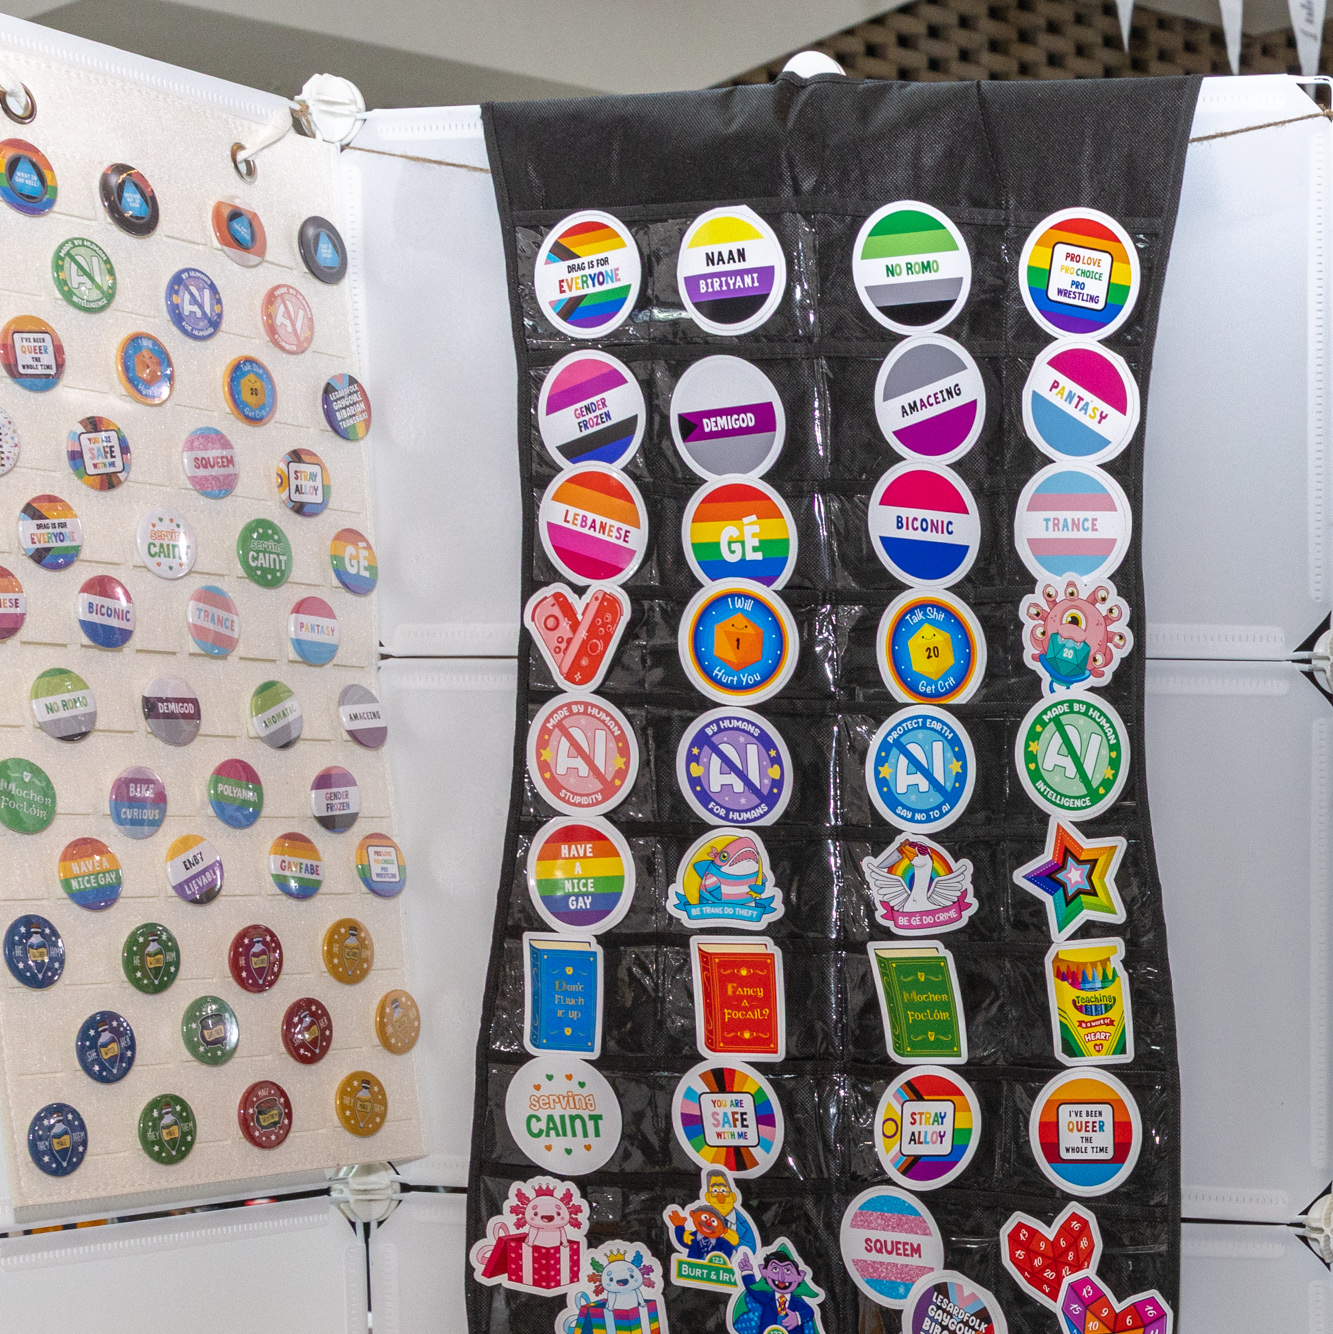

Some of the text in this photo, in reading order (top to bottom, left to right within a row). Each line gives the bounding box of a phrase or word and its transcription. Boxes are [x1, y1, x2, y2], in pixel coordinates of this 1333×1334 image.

[705, 247, 746, 266] NAAN
[885, 259, 940, 277] NO ROMO
[699, 273, 759, 294] BIRIYANI
[573, 397, 608, 419] GENDER
[900, 383, 962, 418] AMACEING
[1049, 380, 1109, 424] PANTASY
[578, 410, 612, 433] FROZEN
[702, 413, 755, 433] DEMIGOD
[193, 455, 235, 470] SQUEEM
[563, 509, 631, 544] LEBANESE
[896, 515, 954, 534] BICONIC
[1043, 516, 1098, 534] TRANCE
[158, 701, 194, 715] DEMIGOD
[560, 843, 594, 859] HAVE
[279, 859, 320, 878] GAYFABE
[574, 862, 581, 874] A
[564, 877, 595, 892] NICE
[568, 894, 592, 909] GAY
[528, 1090, 595, 1112] serving
[711, 1110, 749, 1130] SAFE
[909, 1111, 946, 1126] STRAY
[1069, 1109, 1102, 1118] I'VE BEEN
[1067, 1119, 1106, 1134] QUEER
[908, 1129, 946, 1146] ALLOY
[1080, 1136, 1094, 1144] THE
[1065, 1145, 1109, 1154] WHOLE TIME
[864, 1239, 922, 1258] SQUEEM
[929, 1291, 988, 1334] LESARDFOLK
